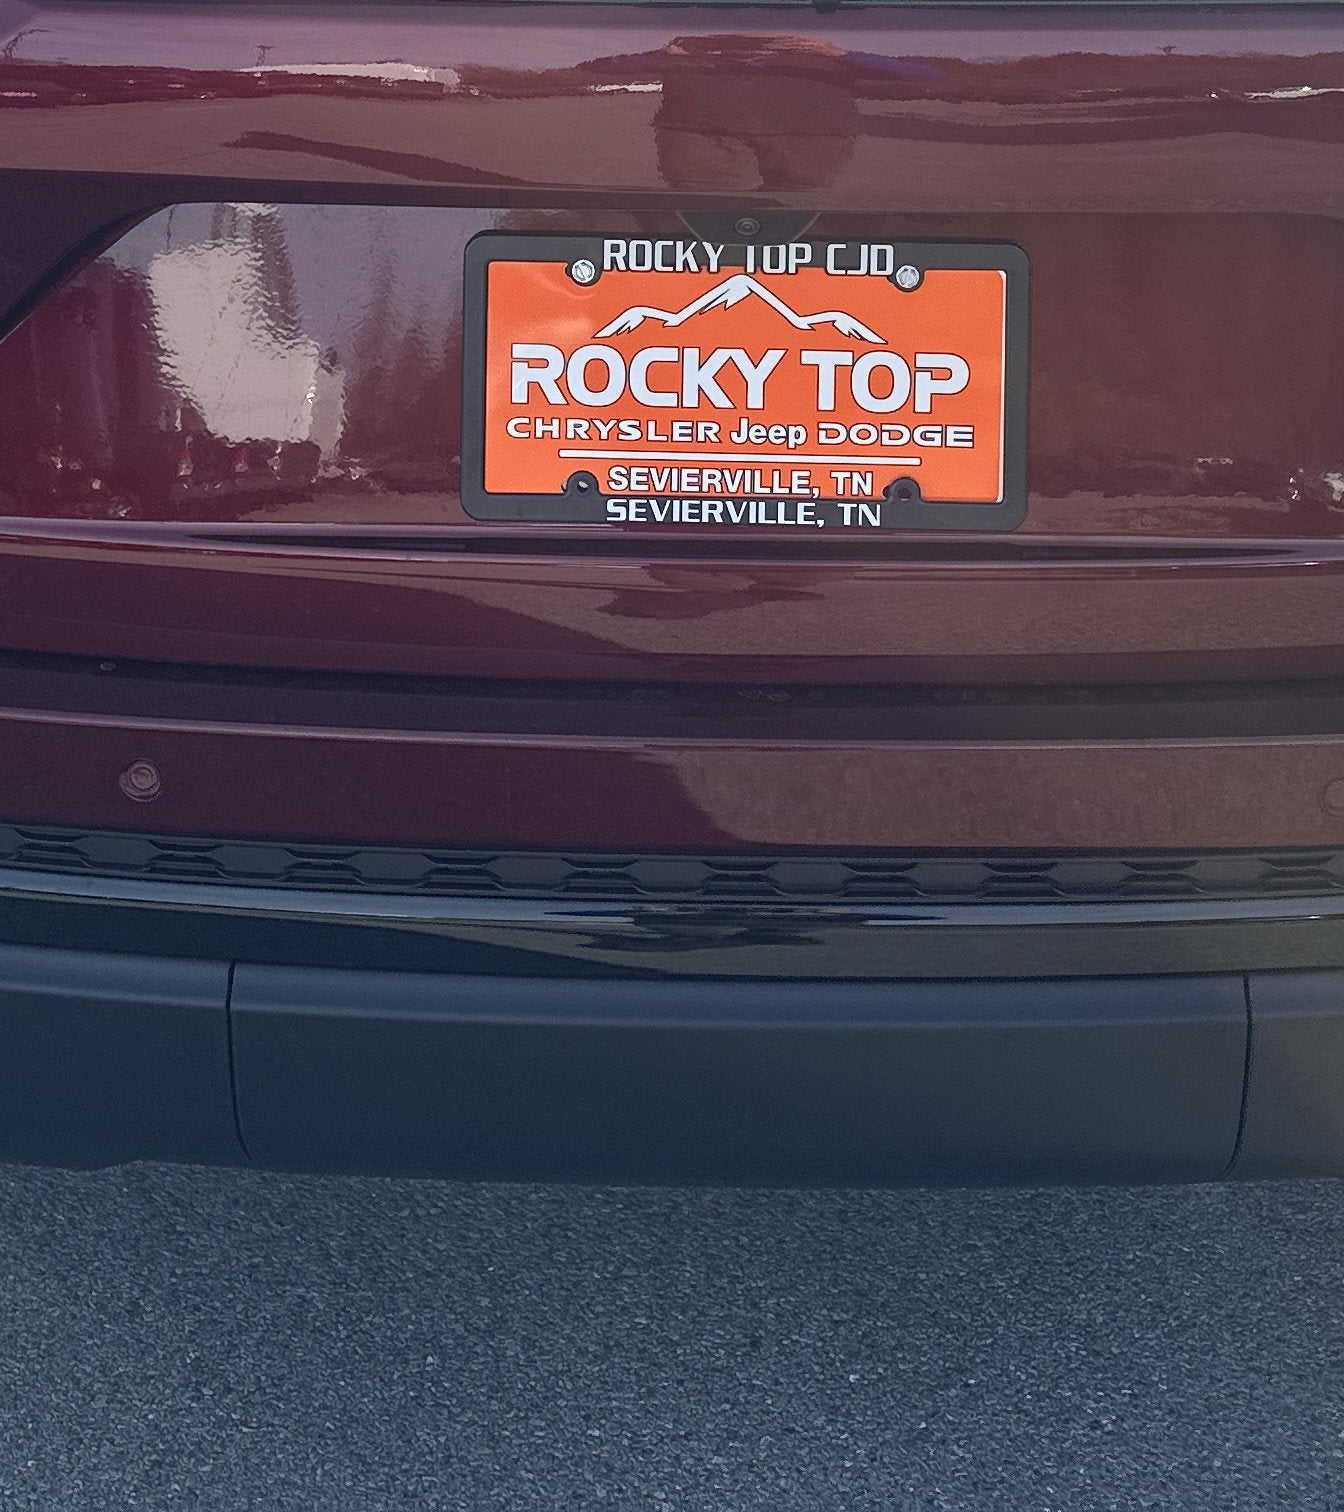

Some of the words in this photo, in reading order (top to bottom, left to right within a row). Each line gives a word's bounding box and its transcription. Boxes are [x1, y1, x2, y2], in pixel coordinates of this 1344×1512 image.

[602, 239, 724, 273] ROCKY
[746, 242, 812, 275] TOP
[826, 244, 894, 276] CJD
[510, 343, 788, 409] ROCKY
[799, 349, 971, 414] TOP
[506, 415, 720, 445] CHRYSLER
[730, 417, 807, 449] Jeep
[817, 426, 974, 448] DODGE
[607, 466, 820, 499] SEVIERVILLE,
[831, 472, 874, 496] TN
[605, 498, 825, 528] SEVIERVILLE,
[837, 503, 881, 527] TN
